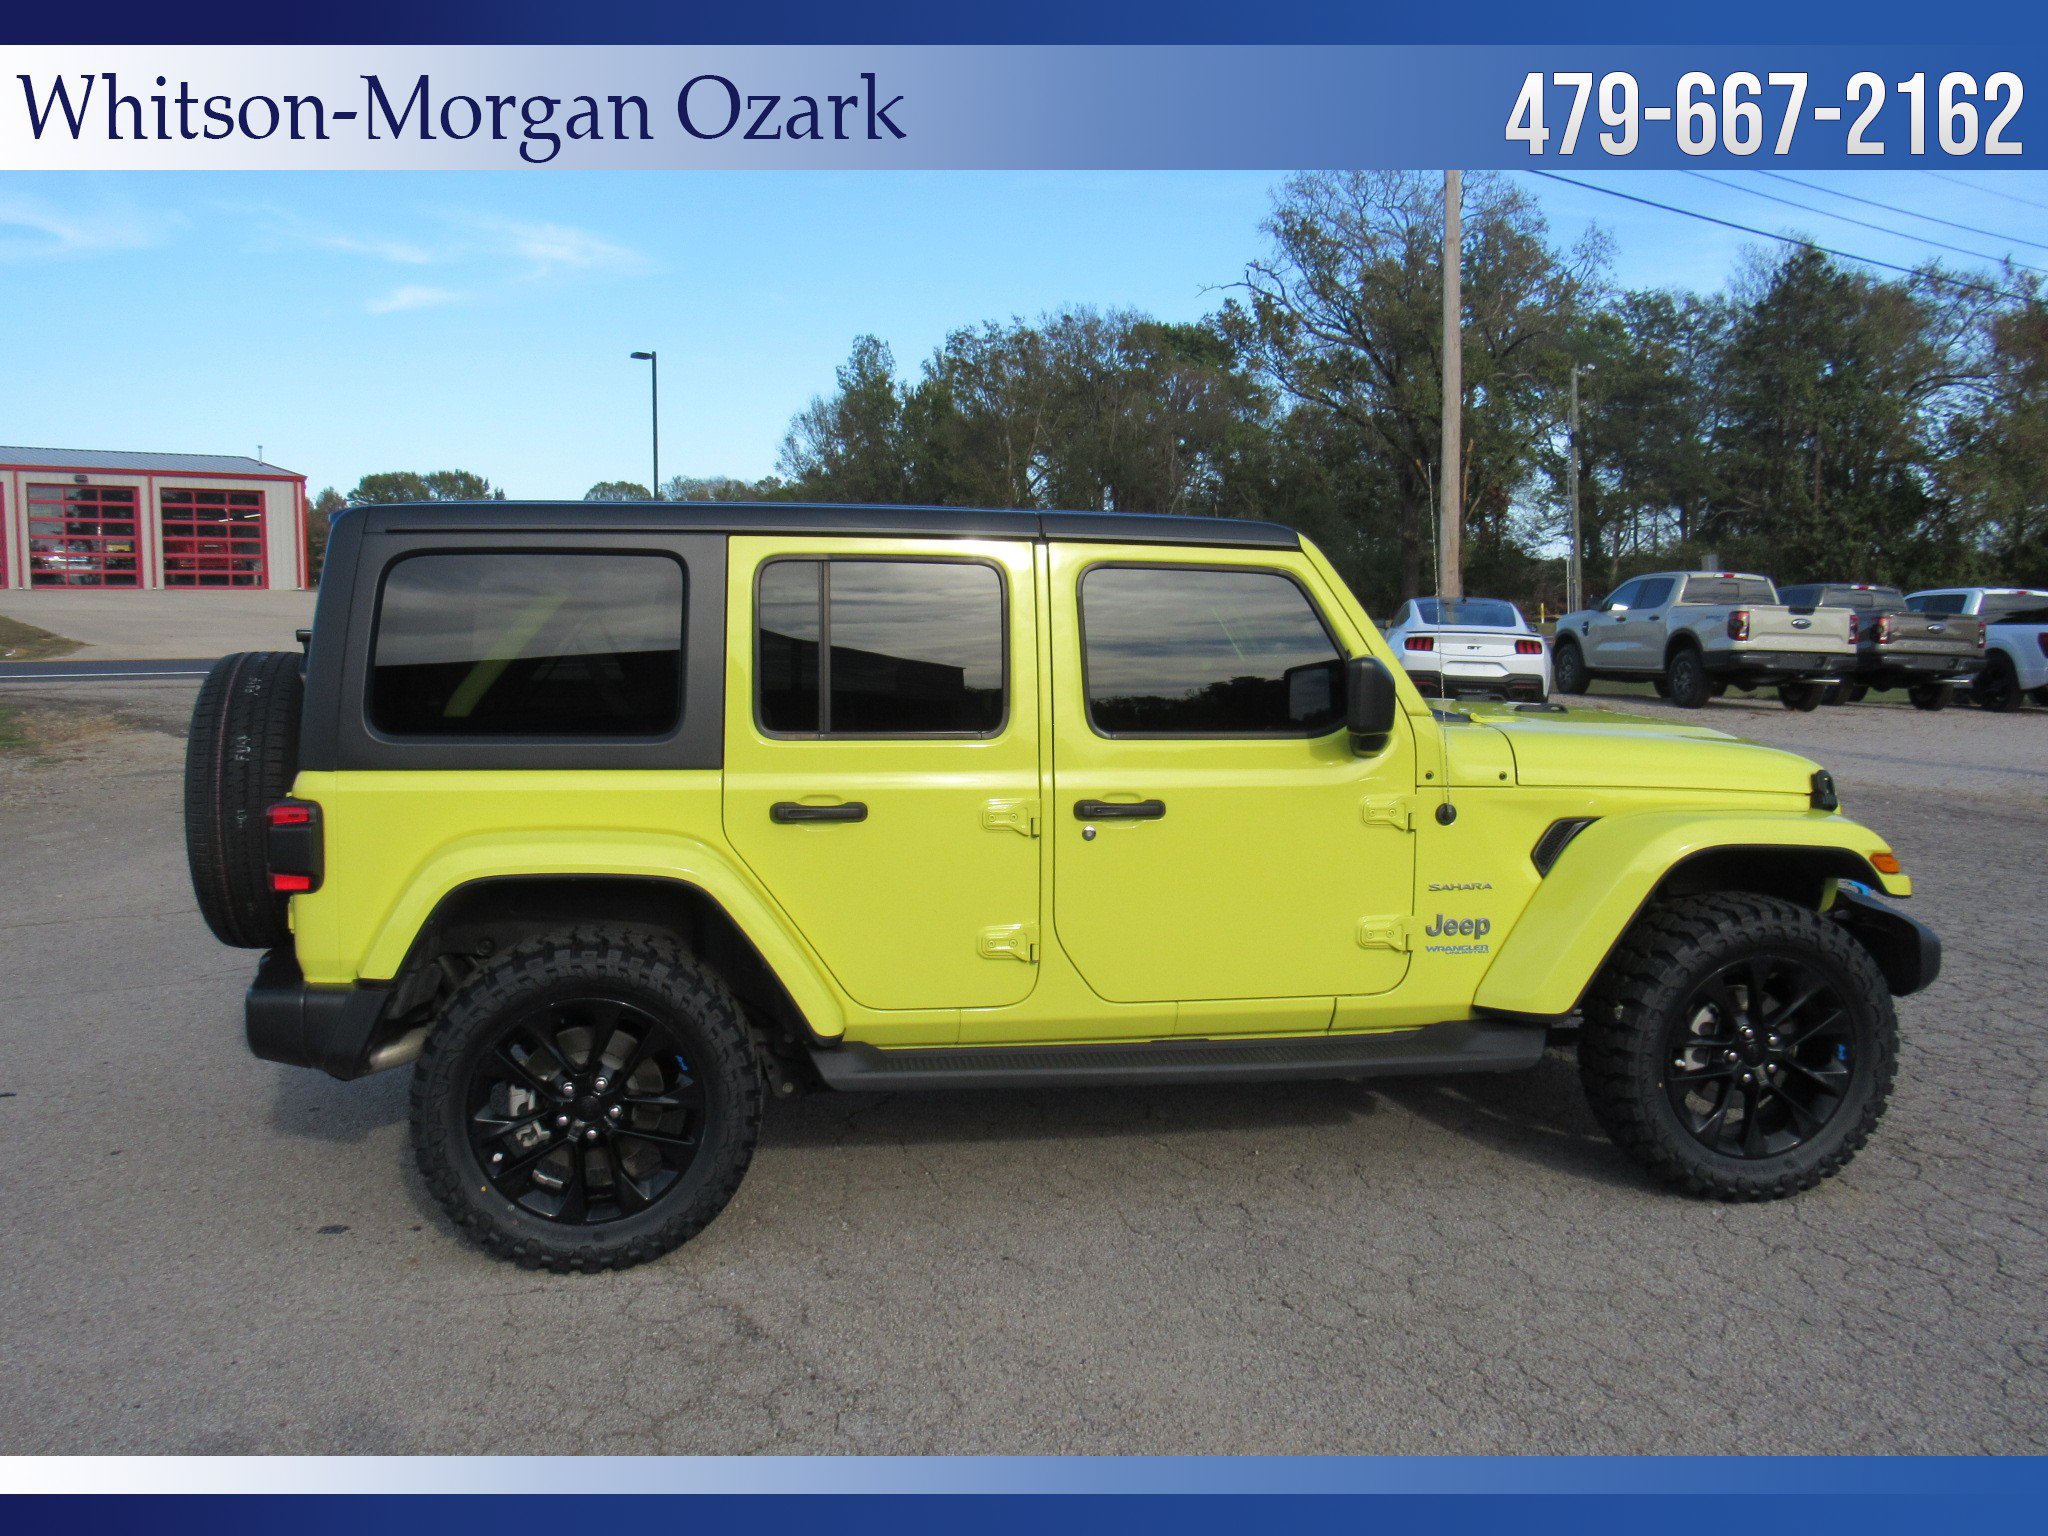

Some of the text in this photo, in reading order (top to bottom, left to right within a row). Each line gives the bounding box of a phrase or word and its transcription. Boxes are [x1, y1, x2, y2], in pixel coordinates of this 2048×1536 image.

[1428, 882, 1492, 891] SAHARA
[1425, 913, 1491, 940] Jeep
[1425, 944, 1489, 953] WRANGLER
